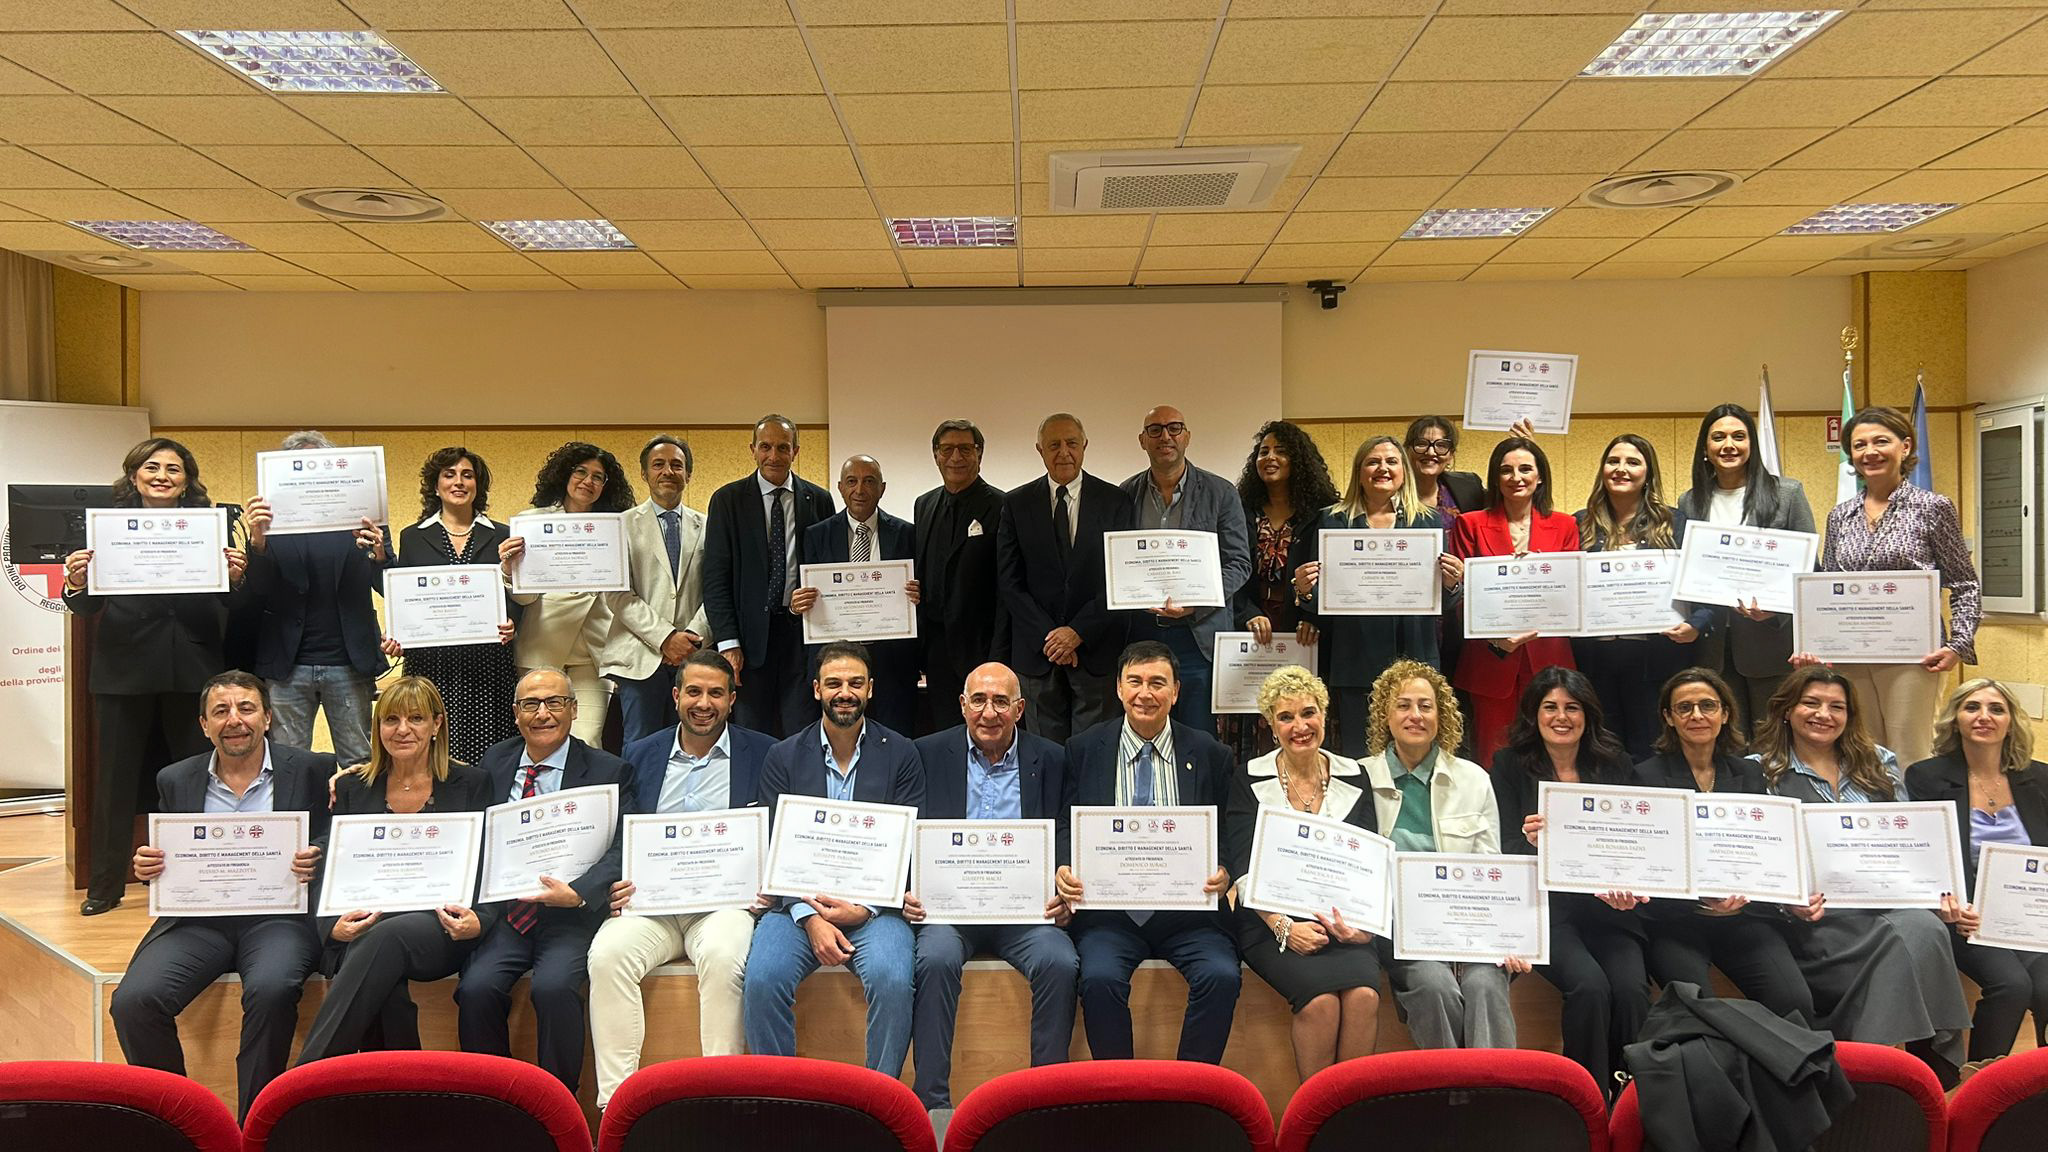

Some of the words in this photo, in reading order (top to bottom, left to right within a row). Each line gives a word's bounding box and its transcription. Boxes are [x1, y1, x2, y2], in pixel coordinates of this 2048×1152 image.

[5, 564, 26, 591] ORDINE
[38, 665, 61, 674] degli
[0, 678, 24, 686] della
